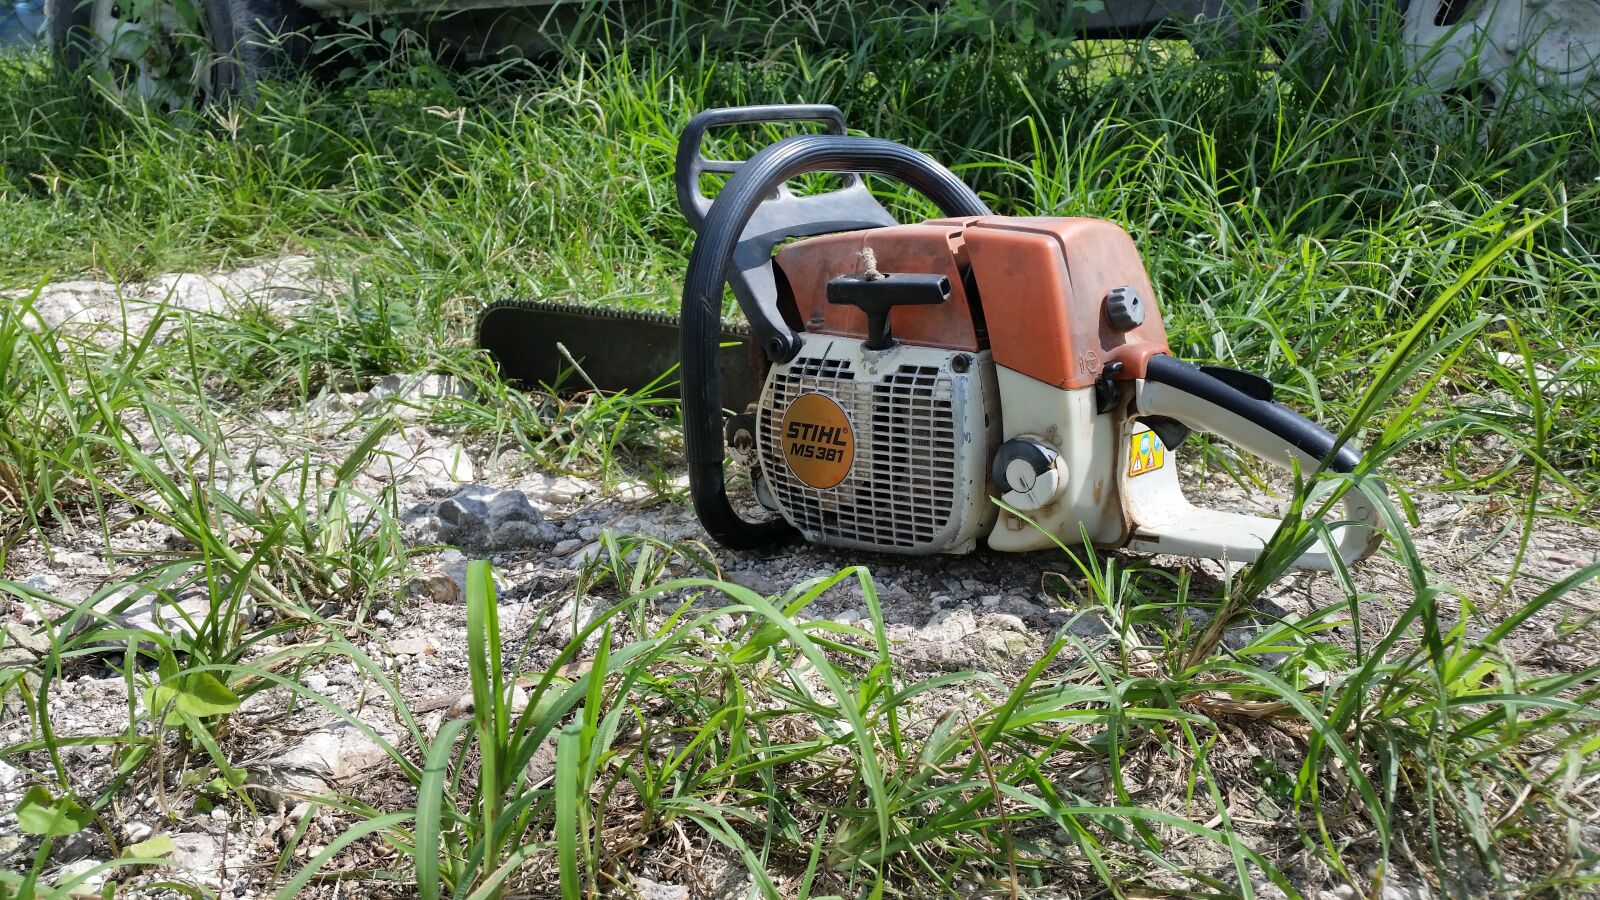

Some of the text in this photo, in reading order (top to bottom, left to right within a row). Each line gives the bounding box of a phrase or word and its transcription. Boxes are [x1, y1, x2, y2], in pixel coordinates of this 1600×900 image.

[787, 421, 847, 446] STIHL
[790, 443, 844, 462] MS 381
